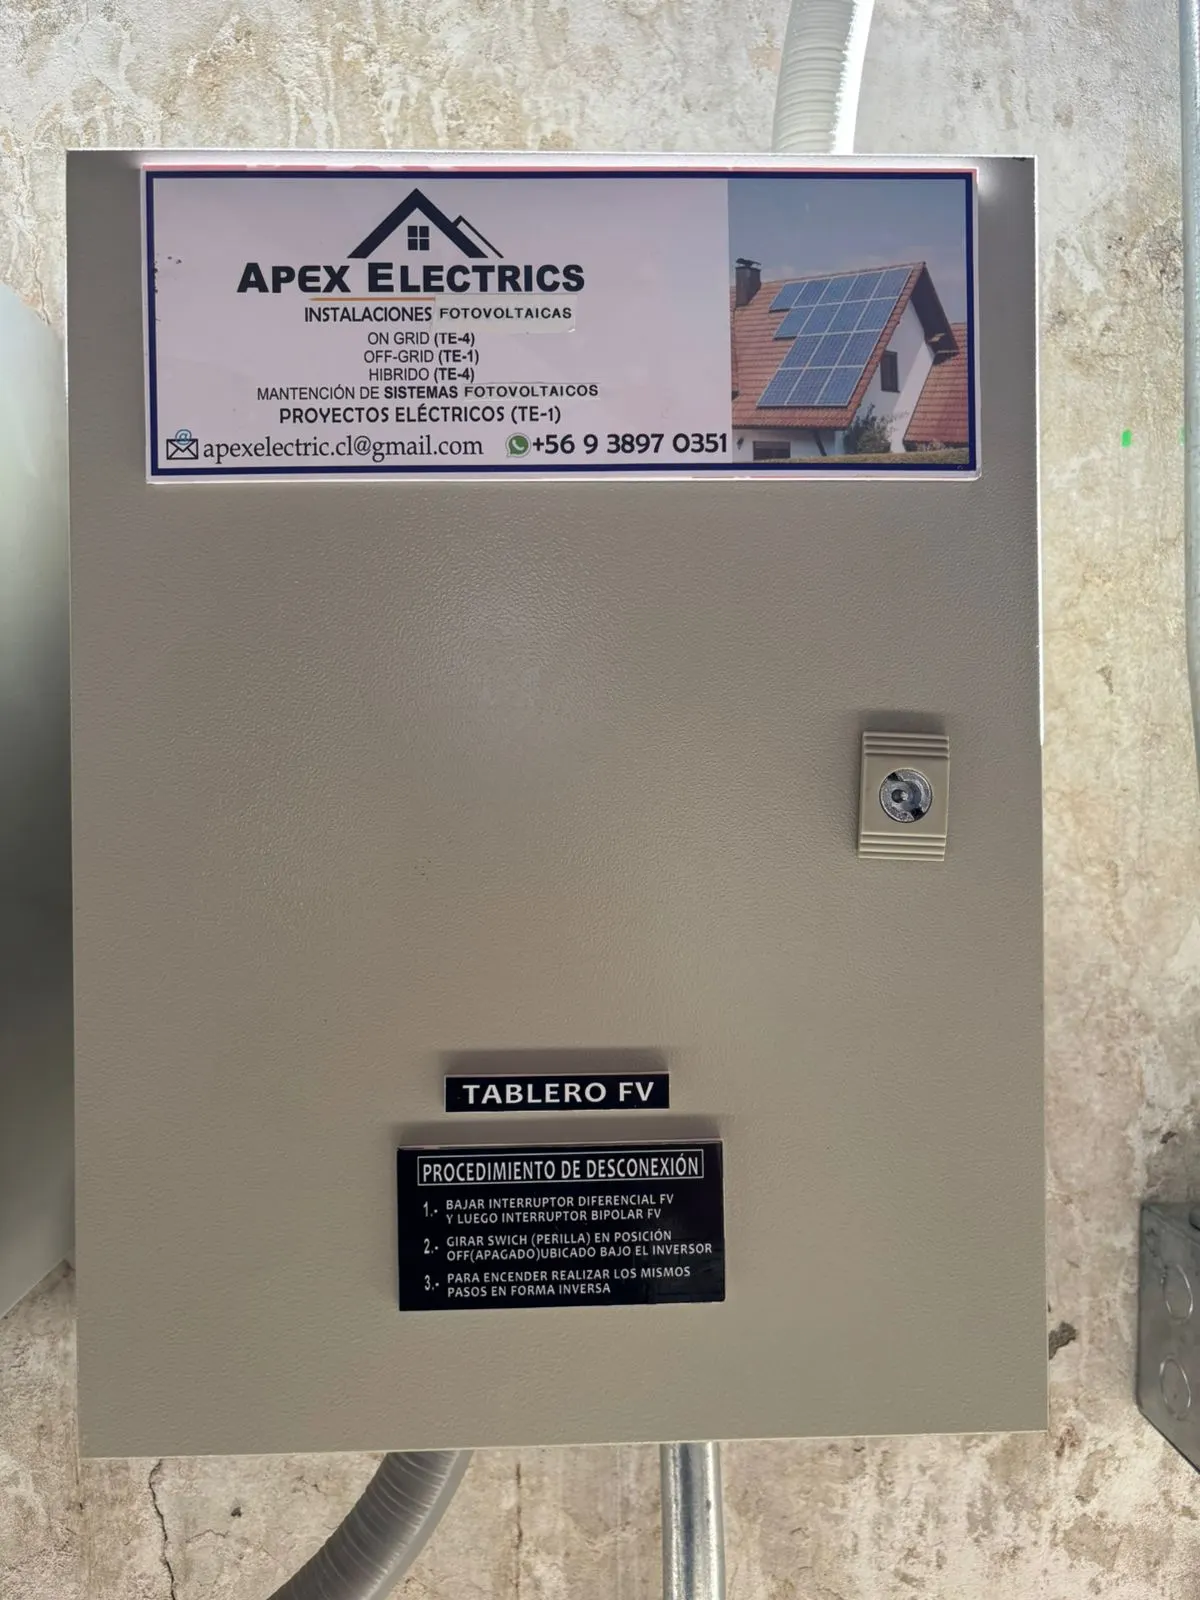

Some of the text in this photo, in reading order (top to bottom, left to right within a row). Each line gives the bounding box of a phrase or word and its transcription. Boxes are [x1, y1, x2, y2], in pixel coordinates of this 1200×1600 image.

[236, 262, 586, 294] APEX ELECTRICS
[304, 307, 572, 323] INSTALACIONES FOTOVOLTAICAS
[367, 332, 476, 347] ON GRID (TE-4)
[363, 349, 479, 365] OFF-GRID (TE-1)
[369, 367, 475, 383] HIBRIDO (TE-4)
[257, 383, 599, 401] MANTENCIÓN DE SISTEMAS FOTOVOLTAICOS
[279, 403, 562, 425] PROYECTOS ELÉCTRICOS (TE-1)
[203, 434, 484, 464] apexelectric.cl@gmail.com
[532, 433, 727, 455] +56 9 3897 0351
[462, 1081, 655, 1105] TABLERO FV
[423, 1153, 699, 1182] PROCEDIMIENTO DE DESCONEXIÓN
[446, 1199, 485, 1211] BAJAR
[488, 1196, 575, 1209] INTERRUPTOR
[578, 1194, 656, 1207] DIFERENCIAL
[660, 1194, 674, 1205] FV
[446, 1208, 662, 1224] Y LUEGO INTERRUPTOR BIPOLAR FV
[446, 1235, 485, 1247] GIRAR
[488, 1233, 528, 1246] SWICH
[531, 1232, 591, 1247] (PERILLA)
[594, 1232, 611, 1243] EN
[614, 1229, 672, 1243] POSICIÓN
[599, 1245, 632, 1257] BAJO
[635, 1245, 649, 1256] EL
[652, 1243, 713, 1256] INVERSOR
[448, 1272, 480, 1284] PARA
[483, 1270, 548, 1283] ENCENDER
[552, 1268, 610, 1280] REALIZAR
[614, 1267, 637, 1279] LOS
[640, 1265, 691, 1278] MISMOS
[448, 1283, 611, 1298] PASOS EN FORMA INVERSA
